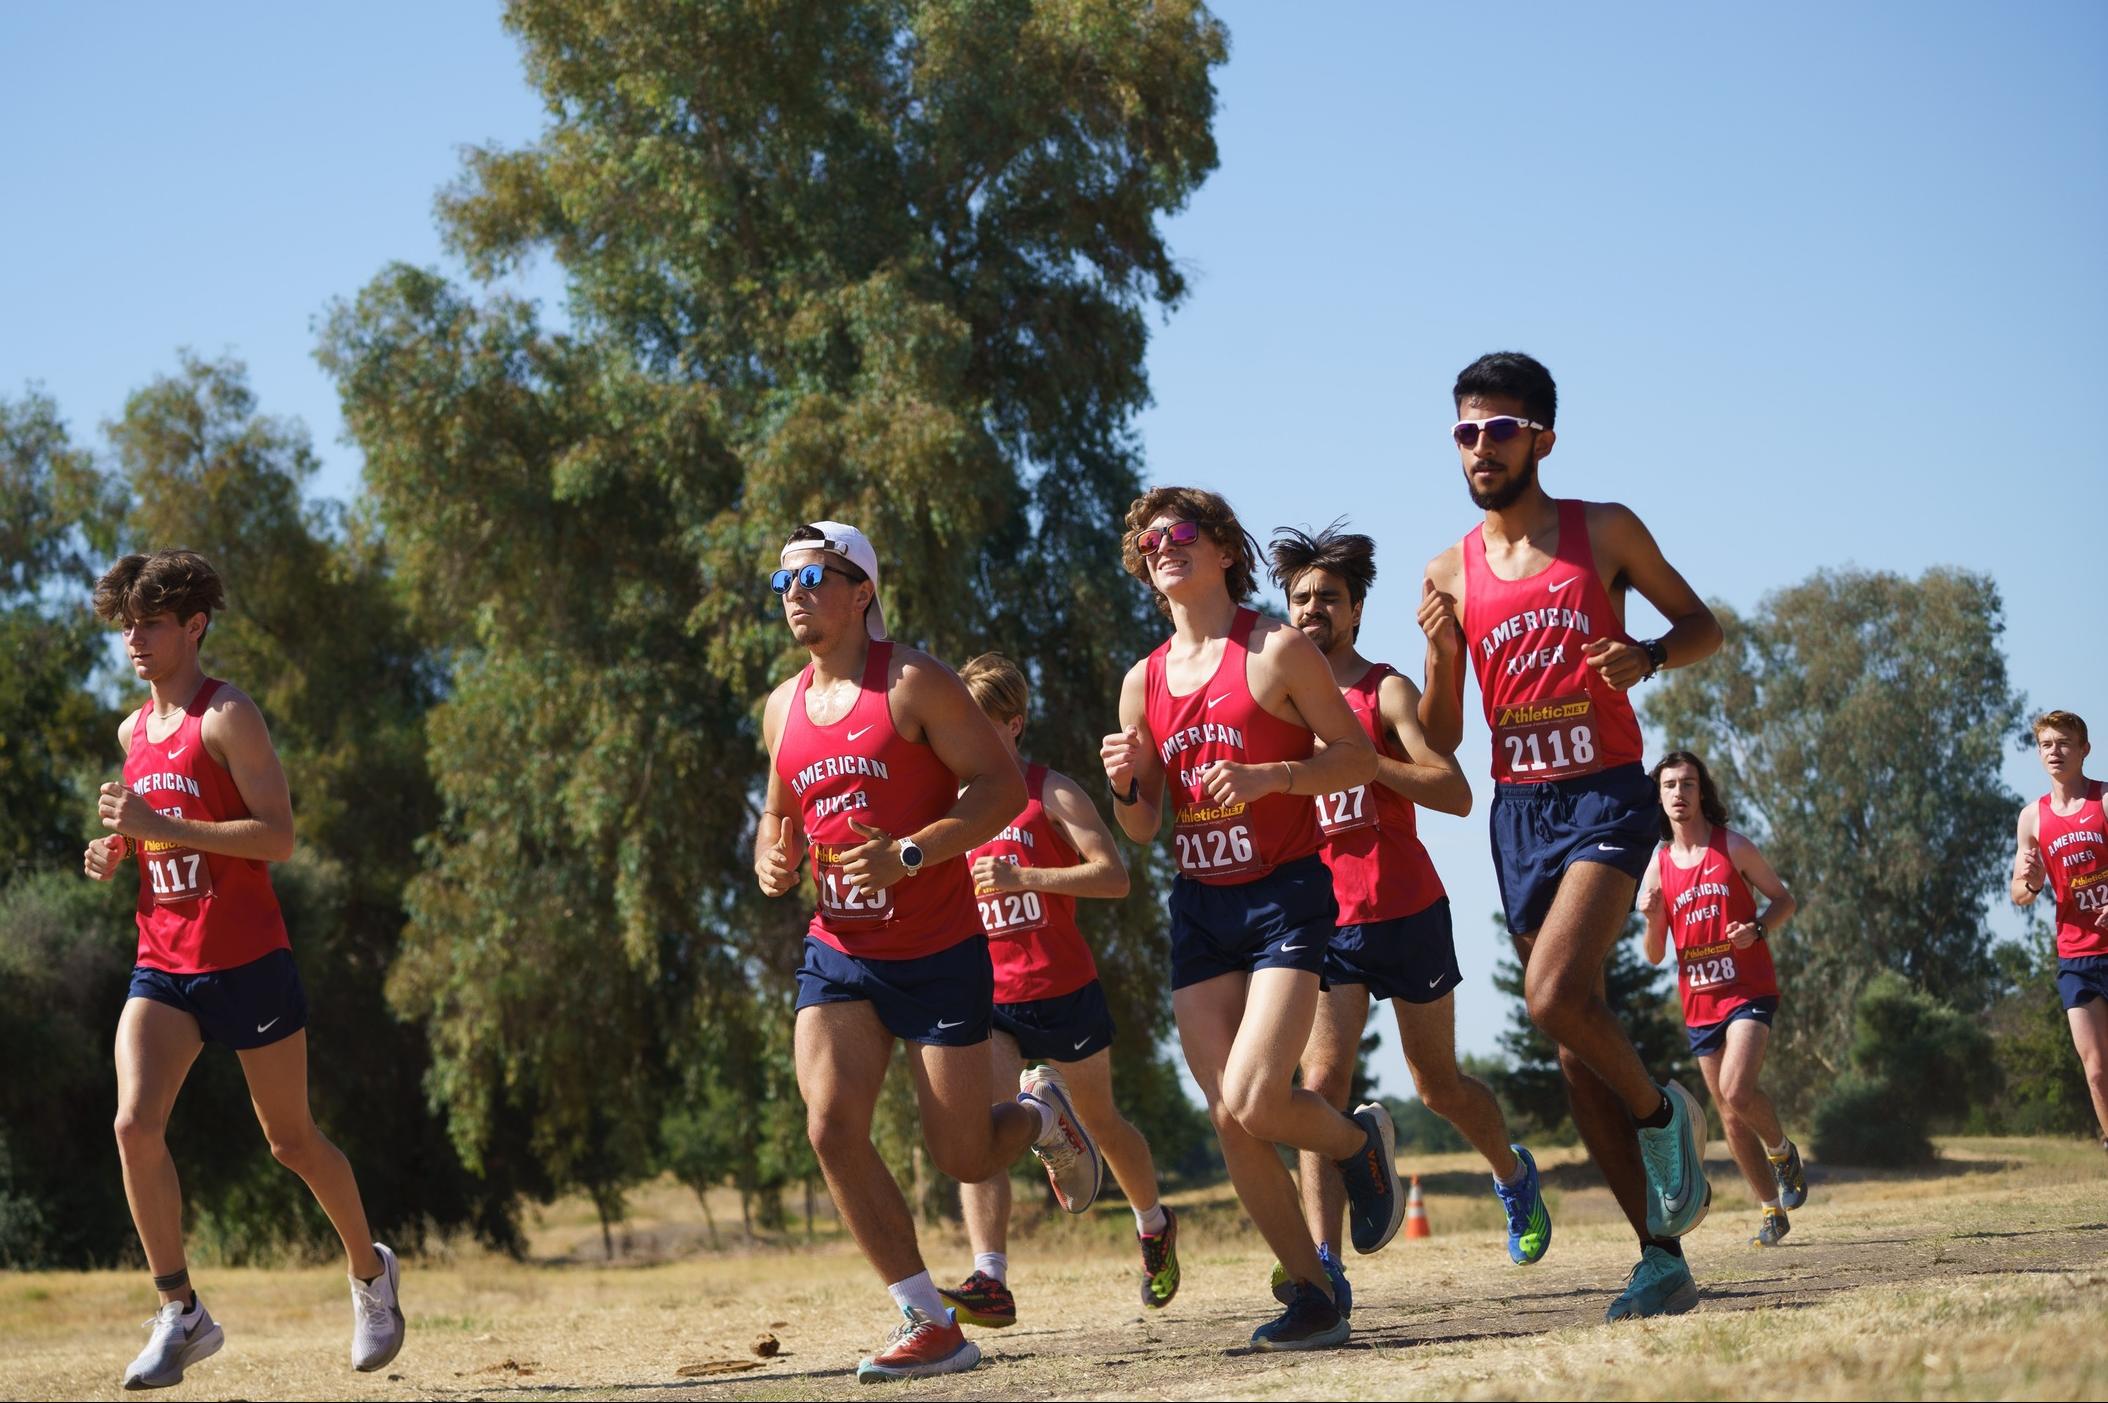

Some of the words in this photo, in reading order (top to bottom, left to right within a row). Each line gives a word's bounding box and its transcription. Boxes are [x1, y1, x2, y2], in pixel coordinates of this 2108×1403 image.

[1481, 607, 1590, 660] AMERICAN
[1507, 644, 1566, 676] RIVER
[1505, 725, 1594, 772] 2118
[133, 772, 200, 797] MERICAN
[791, 755, 889, 796] AMERICAN
[815, 790, 869, 817] RIVER
[1315, 785, 1365, 826] 127
[1176, 825, 1253, 869] 2126
[2048, 830, 2104, 857] AMERICAN
[2062, 849, 2096, 867] RIVER
[977, 891, 1041, 931] 2120
[1673, 882, 1730, 915] AMERICAN
[2075, 884, 2108, 910] 212
[1685, 904, 1720, 926] RIVER
[1687, 956, 1736, 987] 2128
